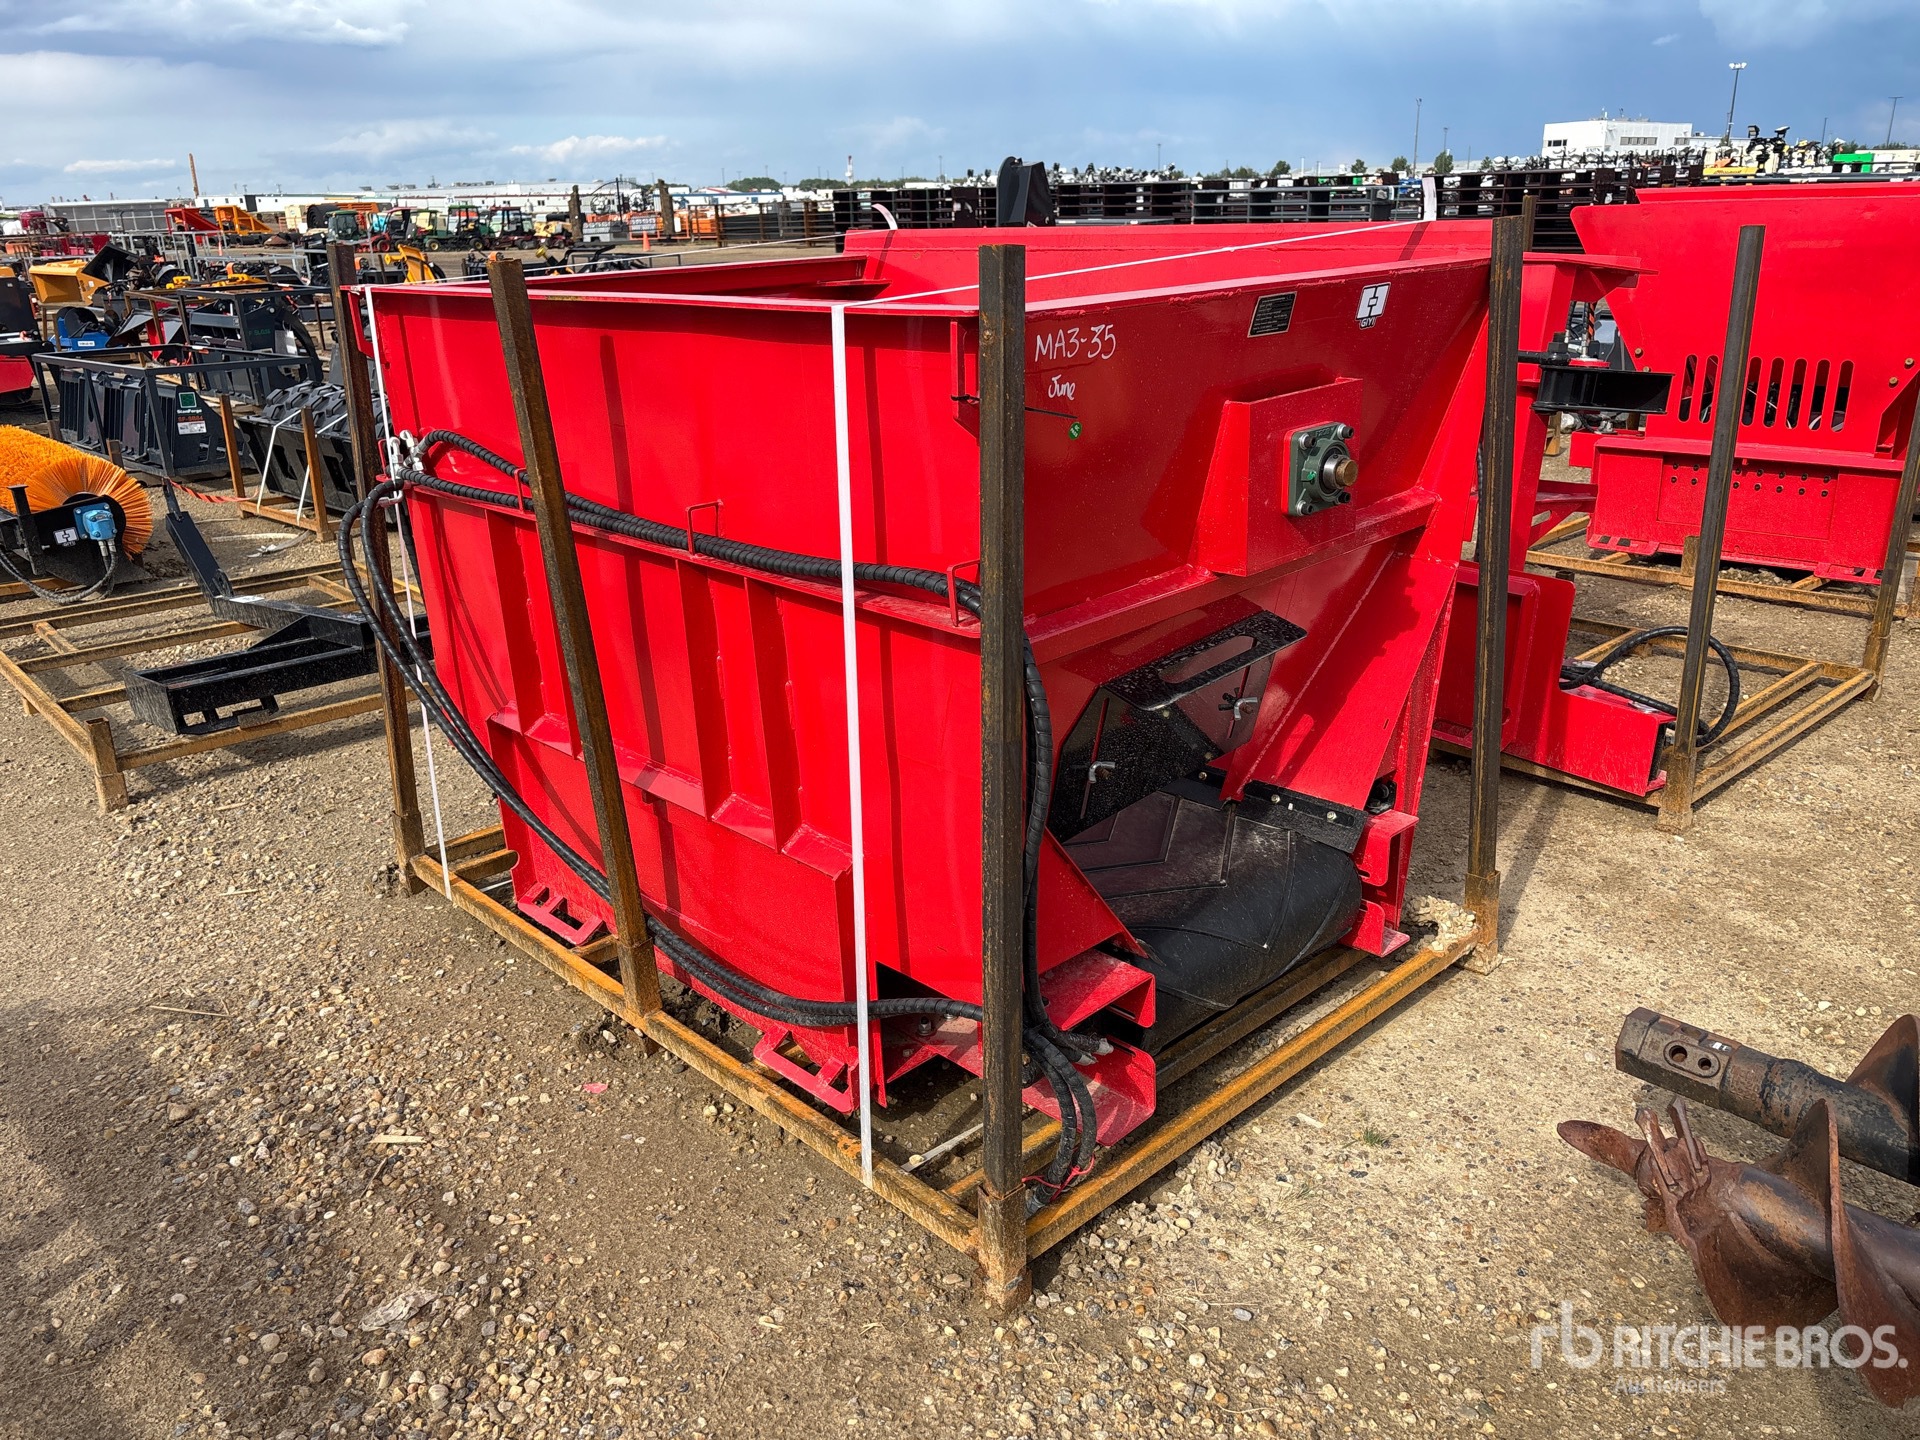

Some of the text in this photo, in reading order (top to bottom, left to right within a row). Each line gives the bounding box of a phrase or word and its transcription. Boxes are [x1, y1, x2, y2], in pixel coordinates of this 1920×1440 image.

[1361, 317, 1376, 327] GIYI
[1035, 324, 1116, 362] MA3-35
[1048, 374, 1076, 401] June
